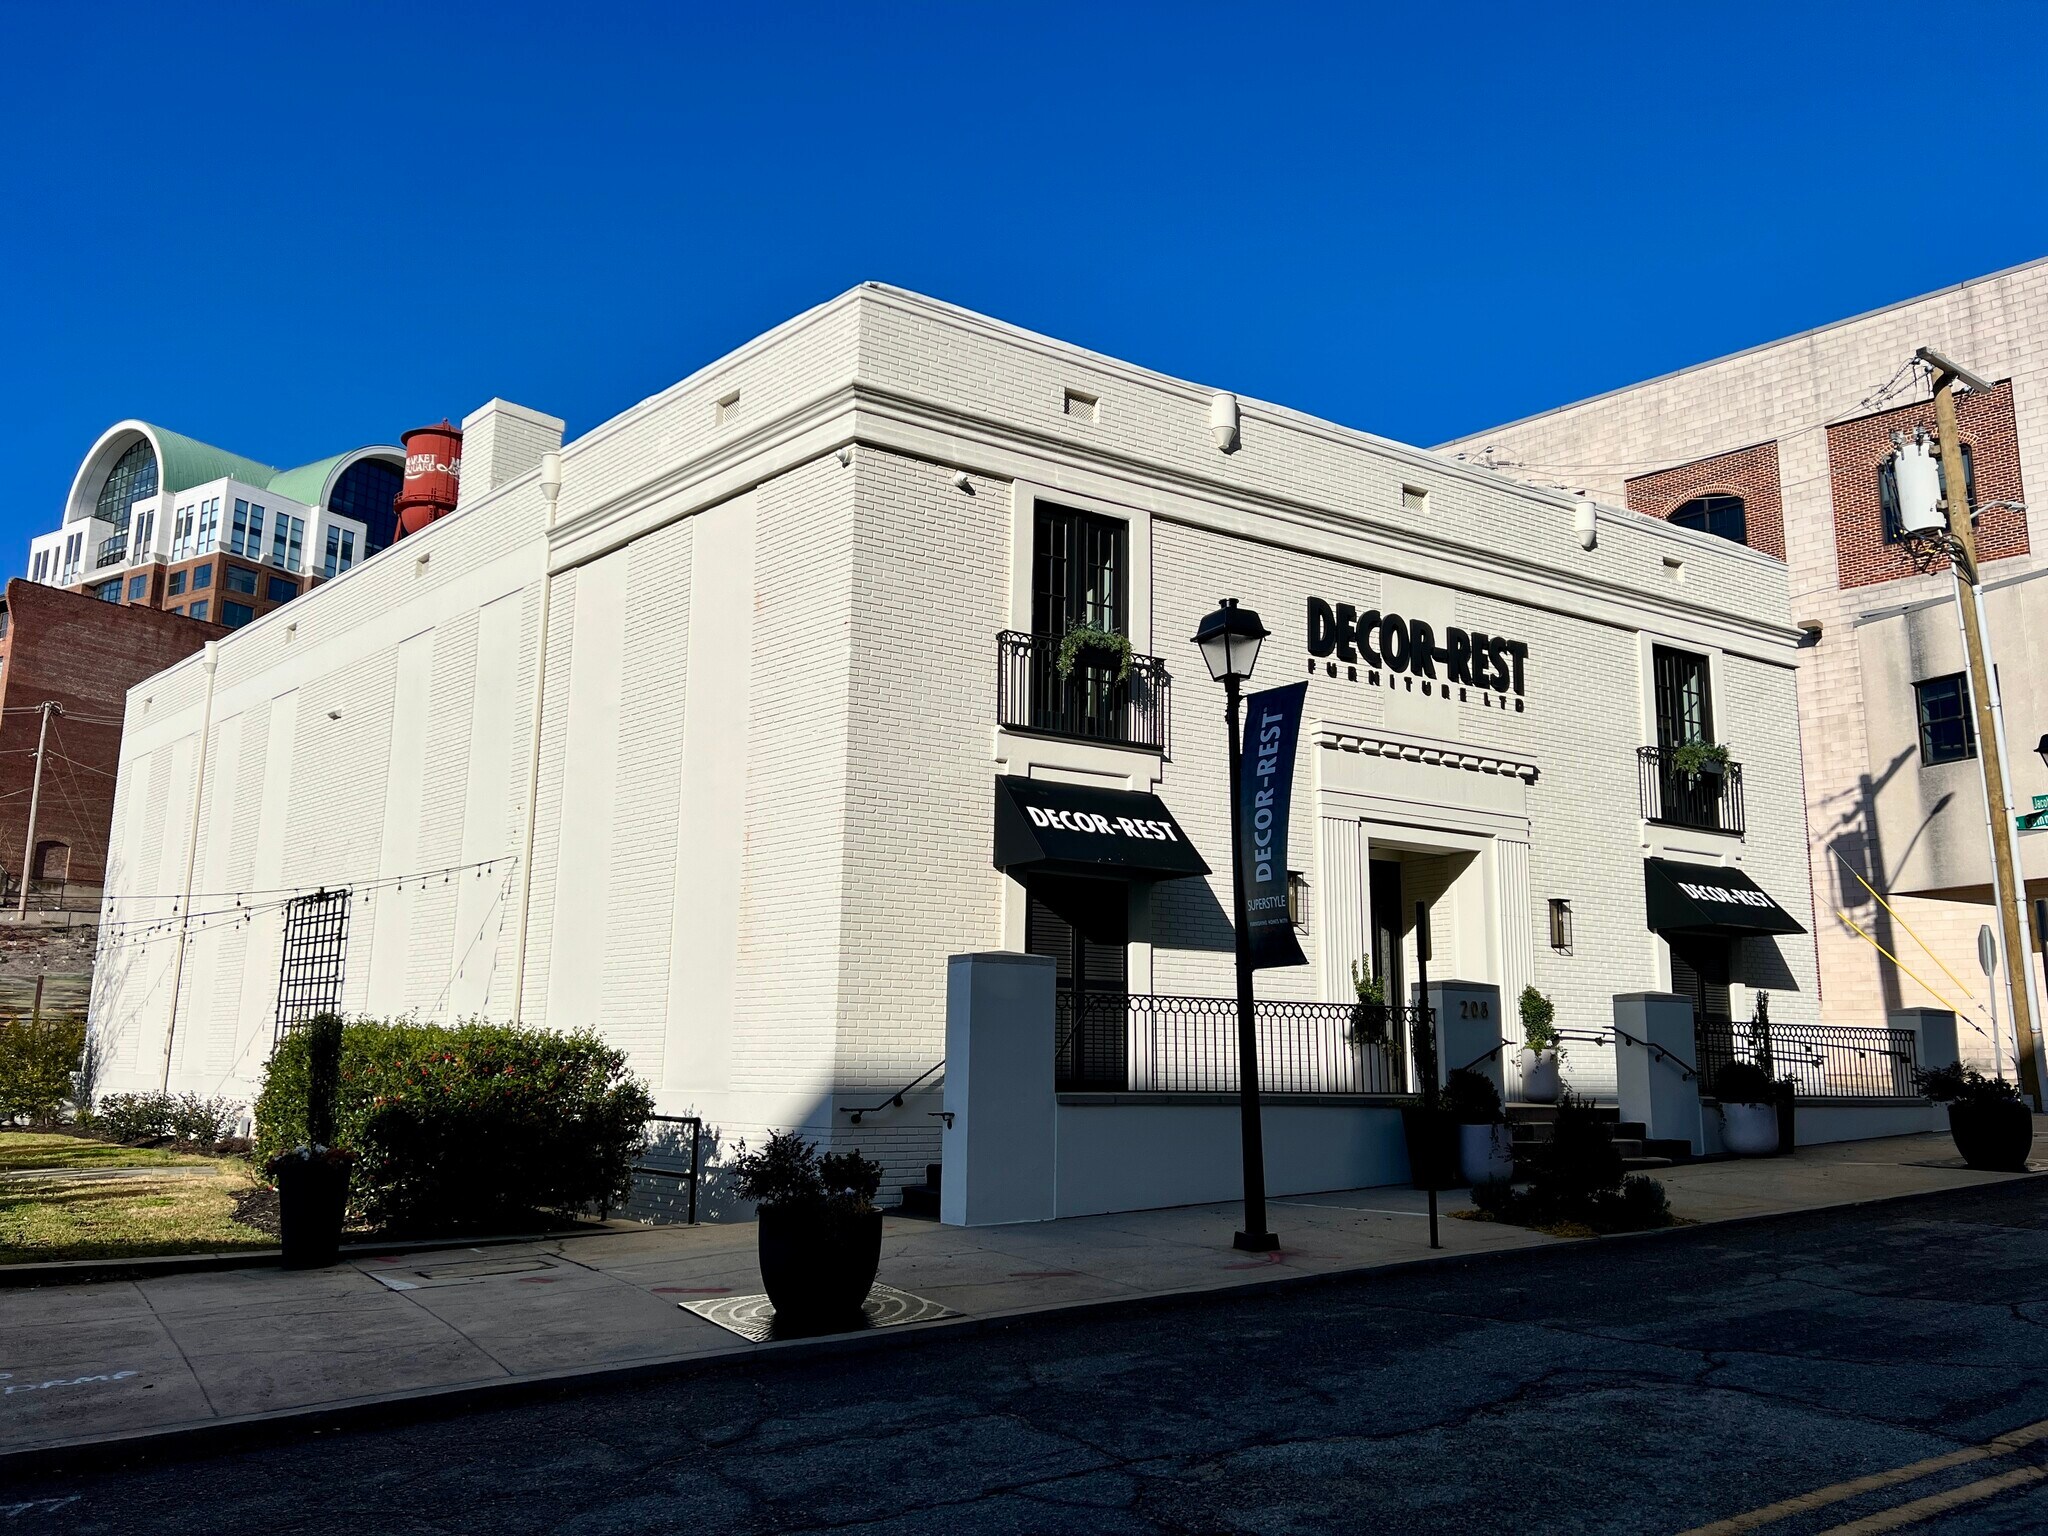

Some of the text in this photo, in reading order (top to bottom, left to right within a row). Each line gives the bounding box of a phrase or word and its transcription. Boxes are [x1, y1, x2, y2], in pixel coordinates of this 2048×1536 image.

[405, 463, 436, 475] SQUARE
[406, 454, 437, 465] MARKET
[1307, 596, 1528, 696] DECOR-REST
[1308, 658, 1524, 713] FURNITURE LTD
[1254, 713, 1283, 883] DECOR-REST
[1026, 805, 1178, 842] DECOR-REST
[1247, 894, 1286, 912] SUPERSTYLE
[1678, 882, 1775, 909] DECOR-REST
[1460, 1000, 1488, 1020] 208
